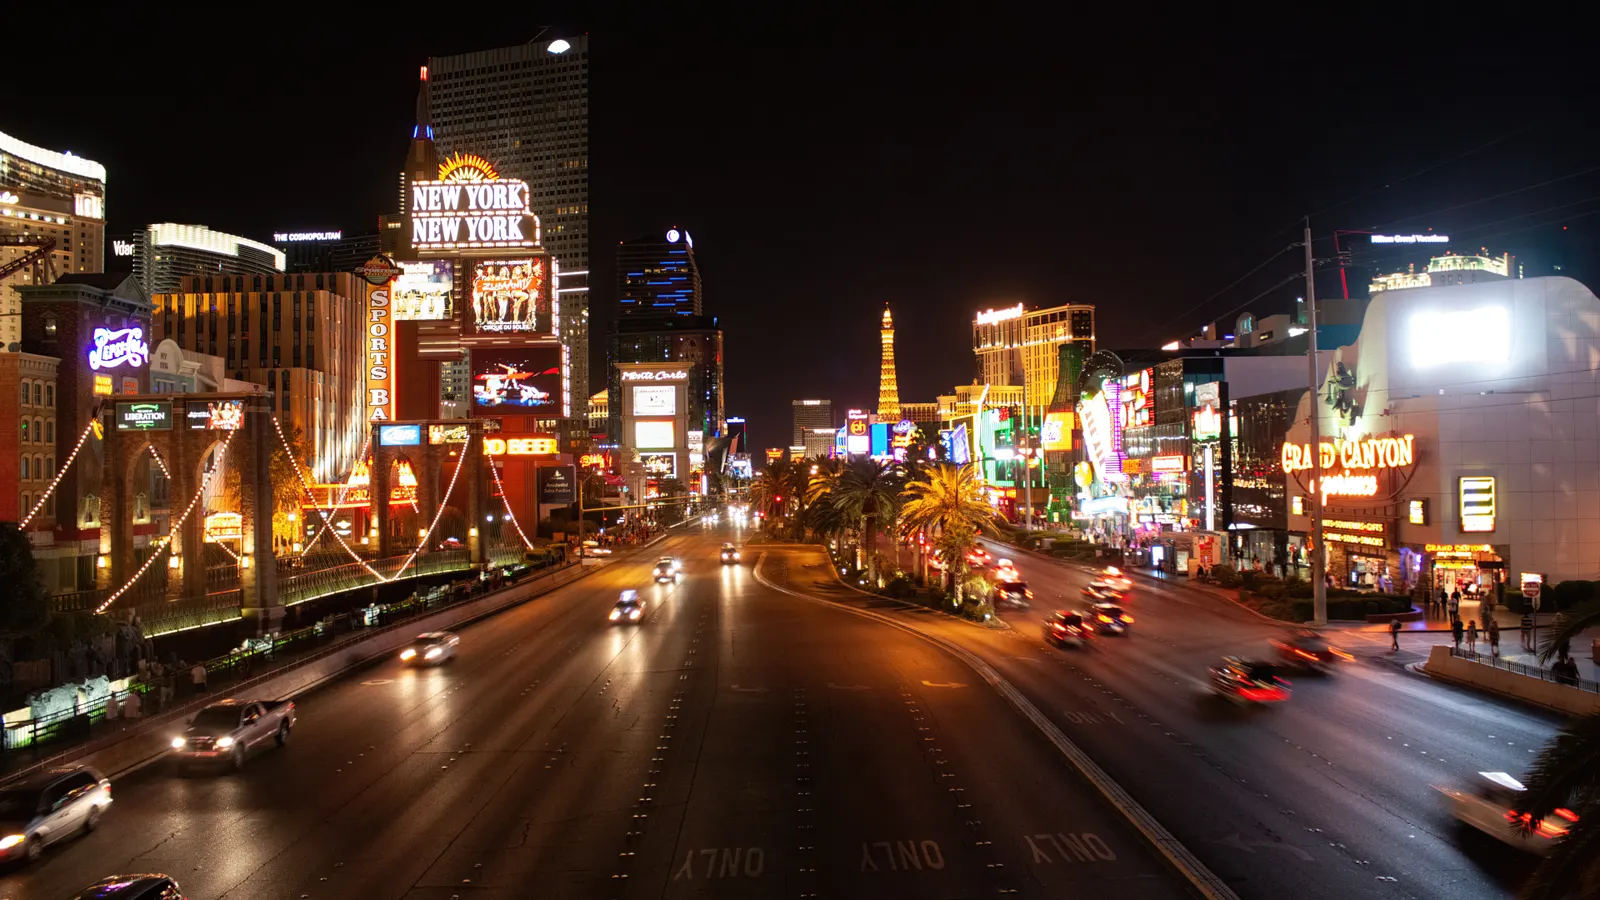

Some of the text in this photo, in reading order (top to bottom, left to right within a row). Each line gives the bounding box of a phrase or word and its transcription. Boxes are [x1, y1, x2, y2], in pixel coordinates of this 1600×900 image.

[413, 184, 523, 211] NEW YORK
[274, 231, 341, 241] THE COSMOPOLITAN
[413, 215, 523, 243] NEW YORK
[482, 278, 531, 291] ZUMANITY
[370, 290, 390, 420] SPORTS BA
[622, 370, 688, 381] Monte Carlo
[125, 412, 165, 420] LIBERATION
[507, 439, 558, 455] BEER
[1341, 434, 1414, 469] CANYON
[1366, 523, 1383, 532] GIFTS
[1360, 536, 1384, 547] SNACKS
[1425, 543, 1484, 552] GRAND CANYON
[861, 839, 945, 872] ONLY
[1023, 832, 1117, 863] ONLY
[674, 847, 764, 882] ONLY
